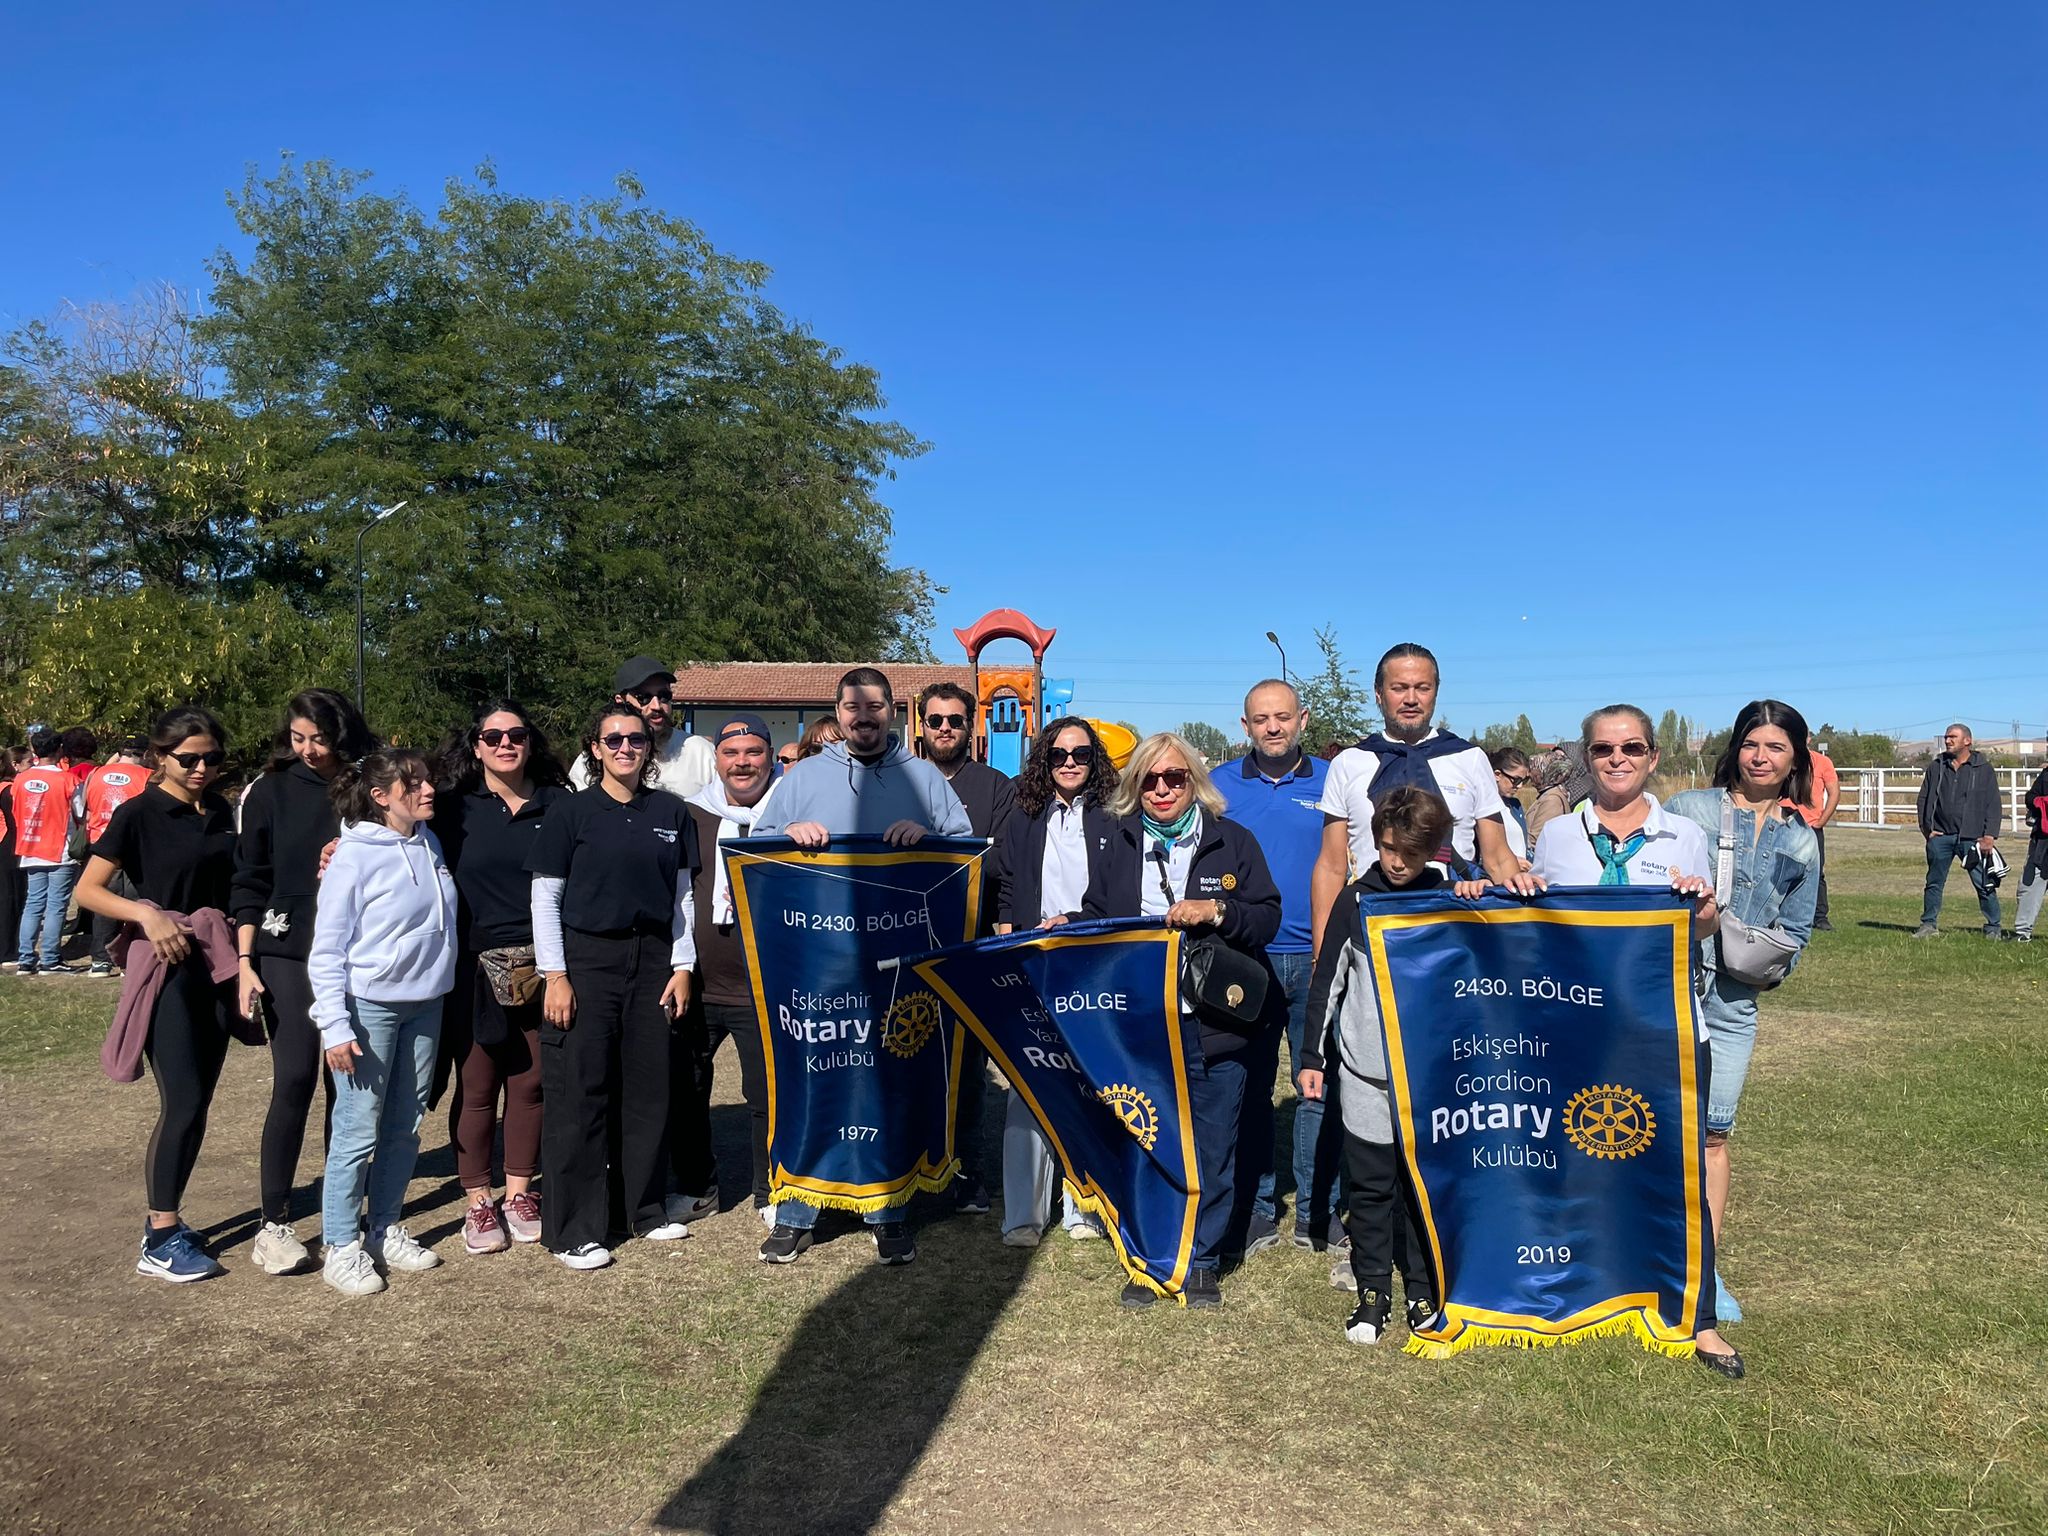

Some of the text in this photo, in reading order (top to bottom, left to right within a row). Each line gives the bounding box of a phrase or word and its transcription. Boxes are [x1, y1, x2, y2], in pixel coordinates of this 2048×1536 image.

[1641, 861, 1667, 872] Rotary
[1200, 877, 1221, 885] Rotary
[783, 907, 930, 932] UR 2430. BÖLGE
[991, 973, 1021, 988] UR
[1454, 976, 1604, 1007] 2430. BÖLGE
[791, 988, 873, 1015] Eskişehir
[1055, 991, 1128, 1013] BÖLGE
[779, 1004, 871, 1044] Rotary
[1452, 1034, 1550, 1061] Eskişehir
[806, 1051, 874, 1073] Kulübü
[1455, 1069, 1551, 1096] Gordion
[1588, 1092, 1627, 1102] ROTARY
[1432, 1101, 1552, 1143] Rotary
[837, 1126, 878, 1142] 1977
[1578, 1133, 1643, 1152] INTERNATIONAL
[1472, 1144, 1557, 1170] Kulübü
[1516, 1245, 1571, 1264] 2019
